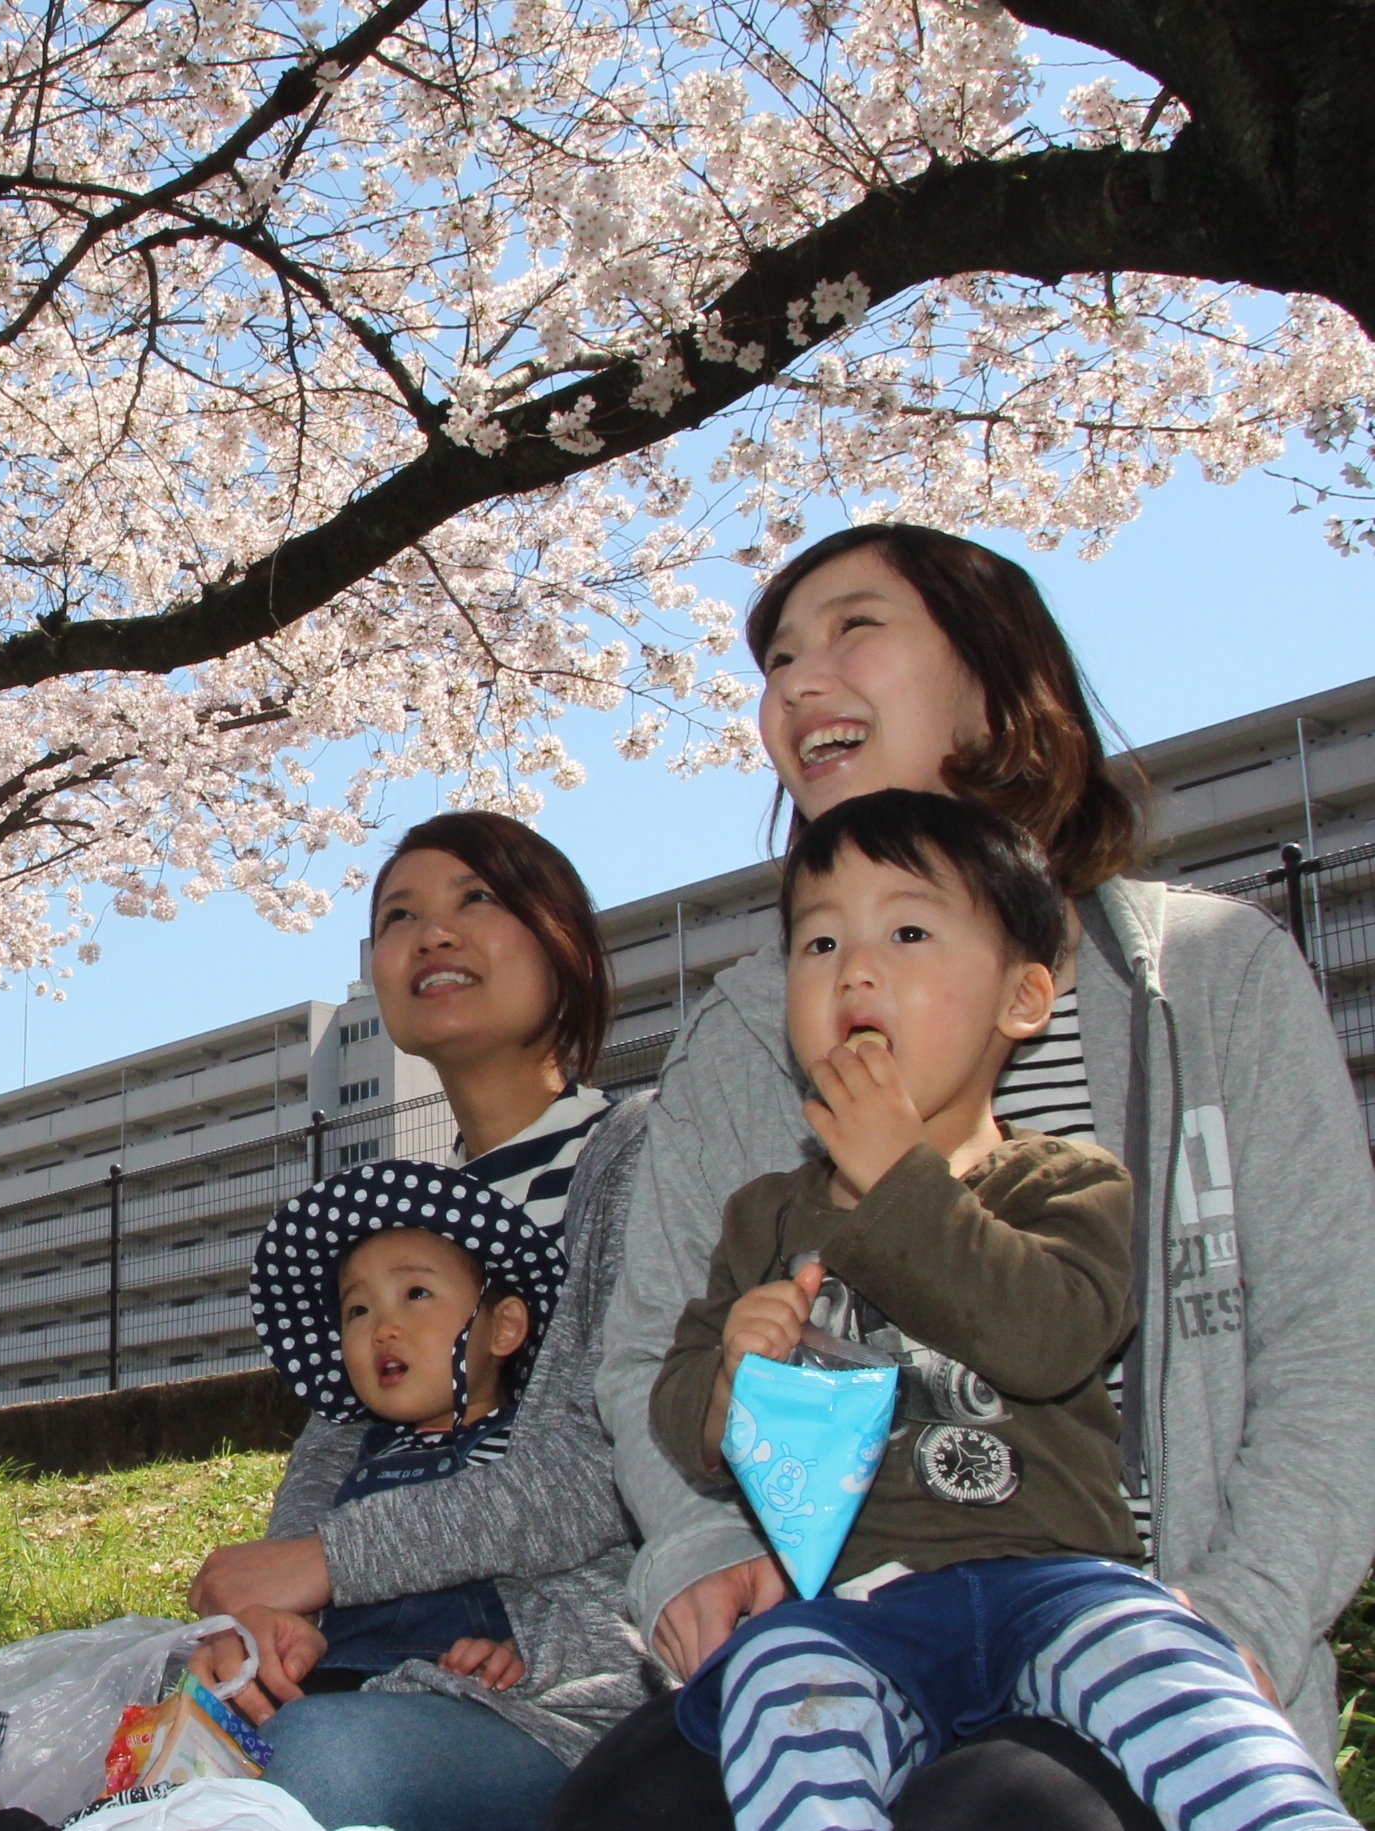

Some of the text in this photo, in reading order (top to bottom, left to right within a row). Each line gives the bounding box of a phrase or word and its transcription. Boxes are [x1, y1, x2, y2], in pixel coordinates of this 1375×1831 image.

[942, 1440, 952, 1451] S
[980, 1437, 993, 1450] W
[988, 1450, 999, 1461] 30
[947, 1472, 959, 1484] E
